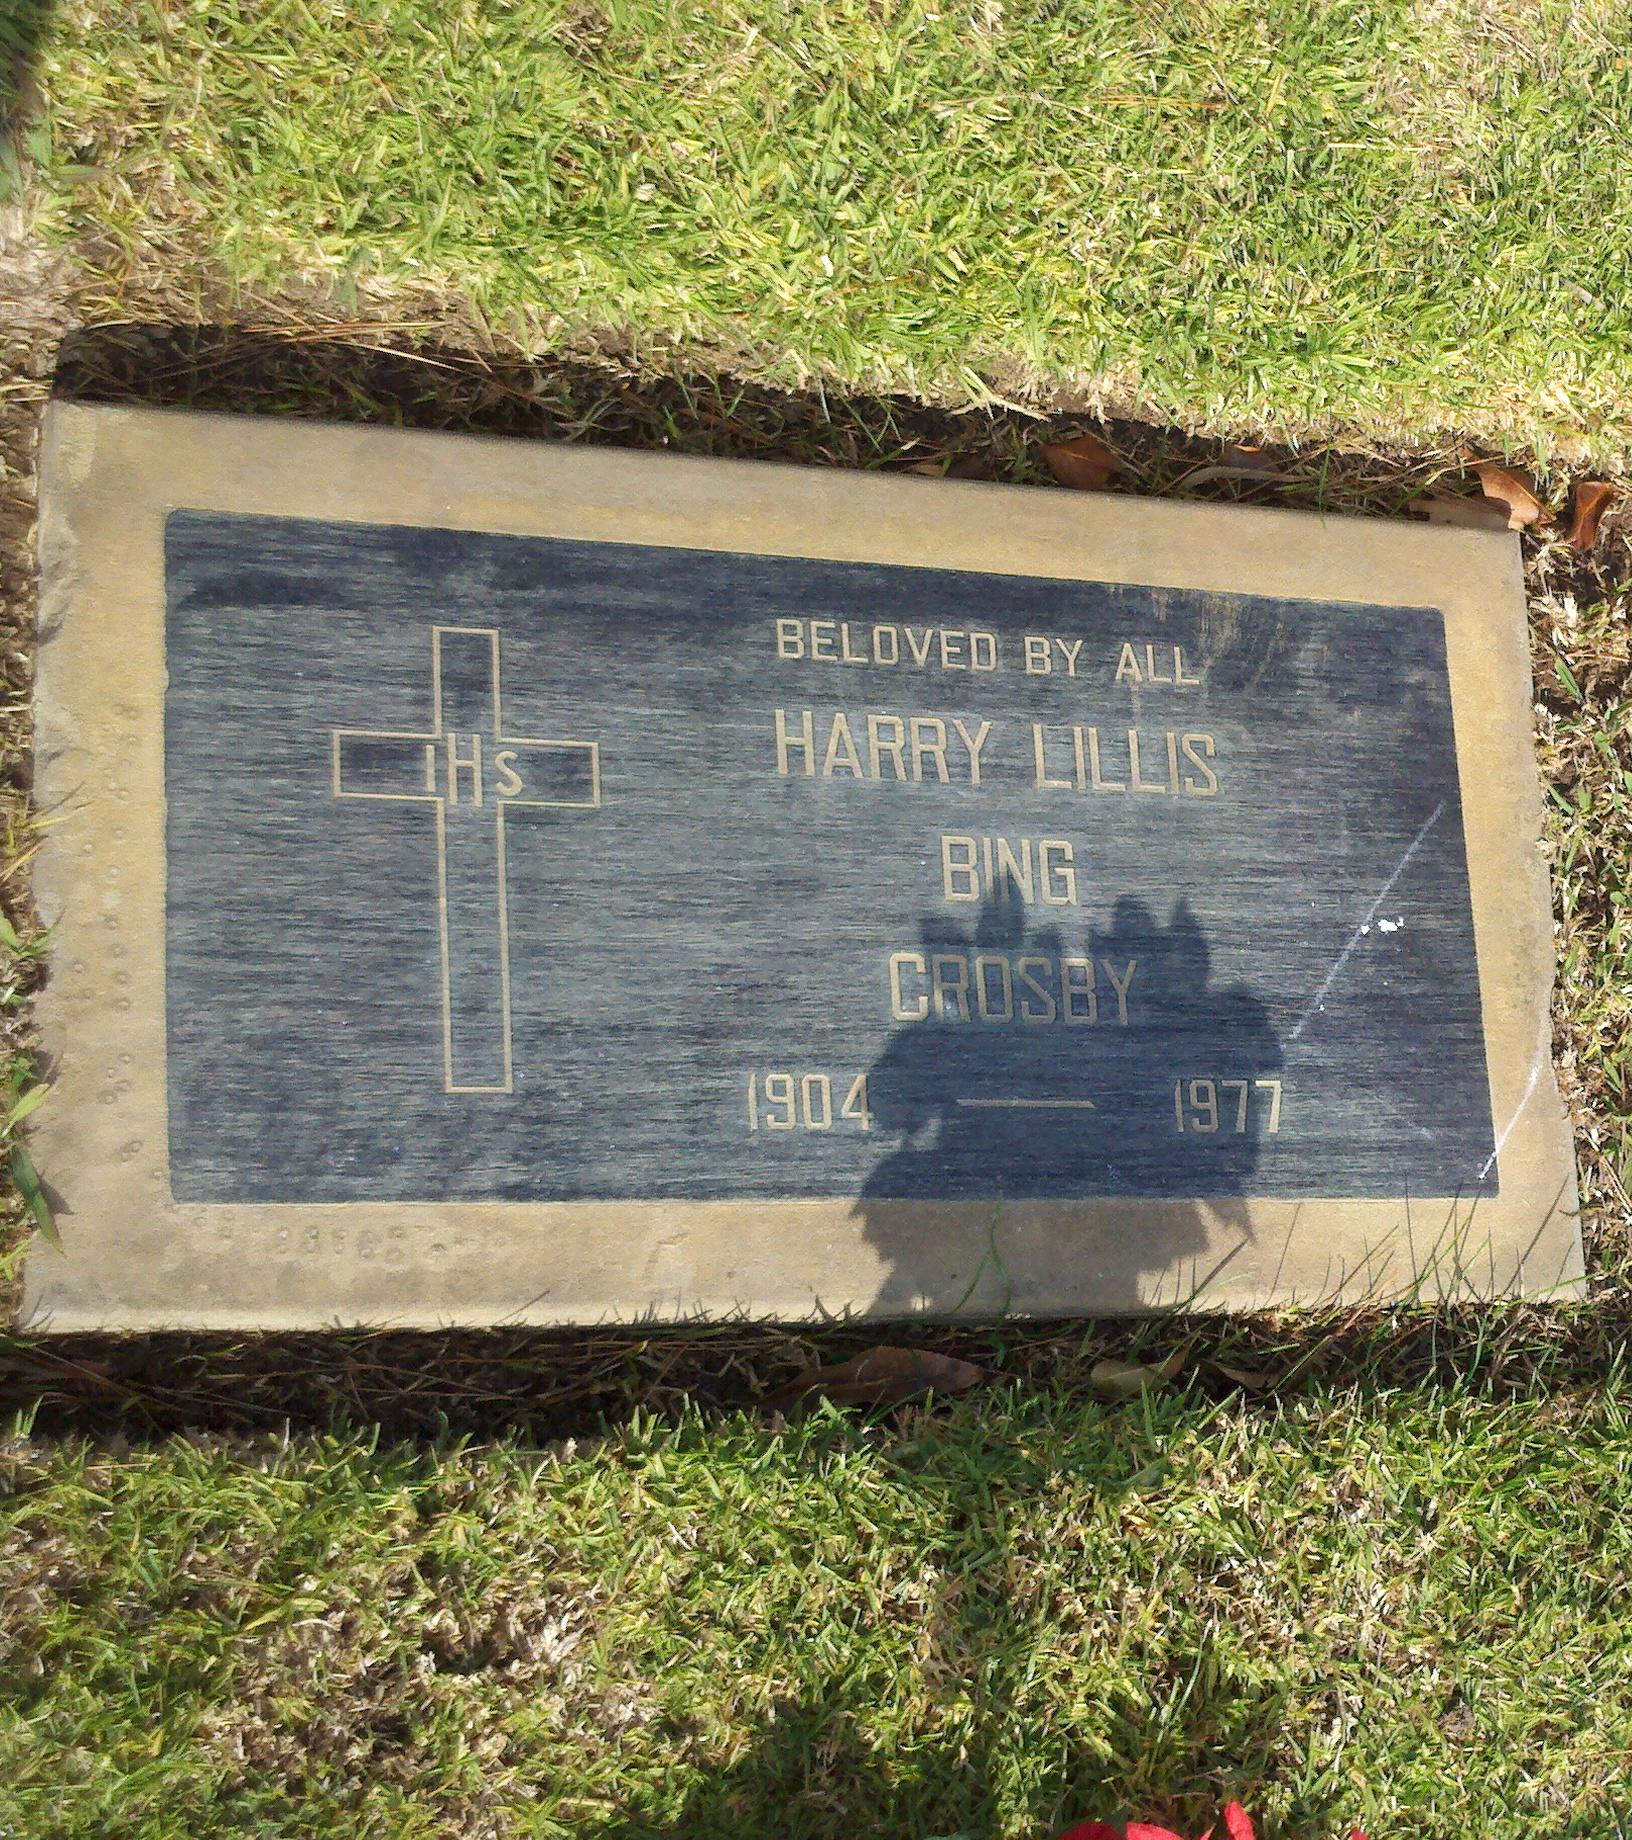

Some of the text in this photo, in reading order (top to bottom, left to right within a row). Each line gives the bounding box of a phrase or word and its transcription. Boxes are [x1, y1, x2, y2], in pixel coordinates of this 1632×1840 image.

[776, 618, 1201, 686] BELOVED BY ALL
[775, 708, 1220, 798] HARRY LILLIS
[940, 834, 1079, 906] BING
[888, 951, 1138, 1026] CROSBY
[747, 1070, 873, 1132] 1904
[1172, 1077, 1284, 1135] 1977
